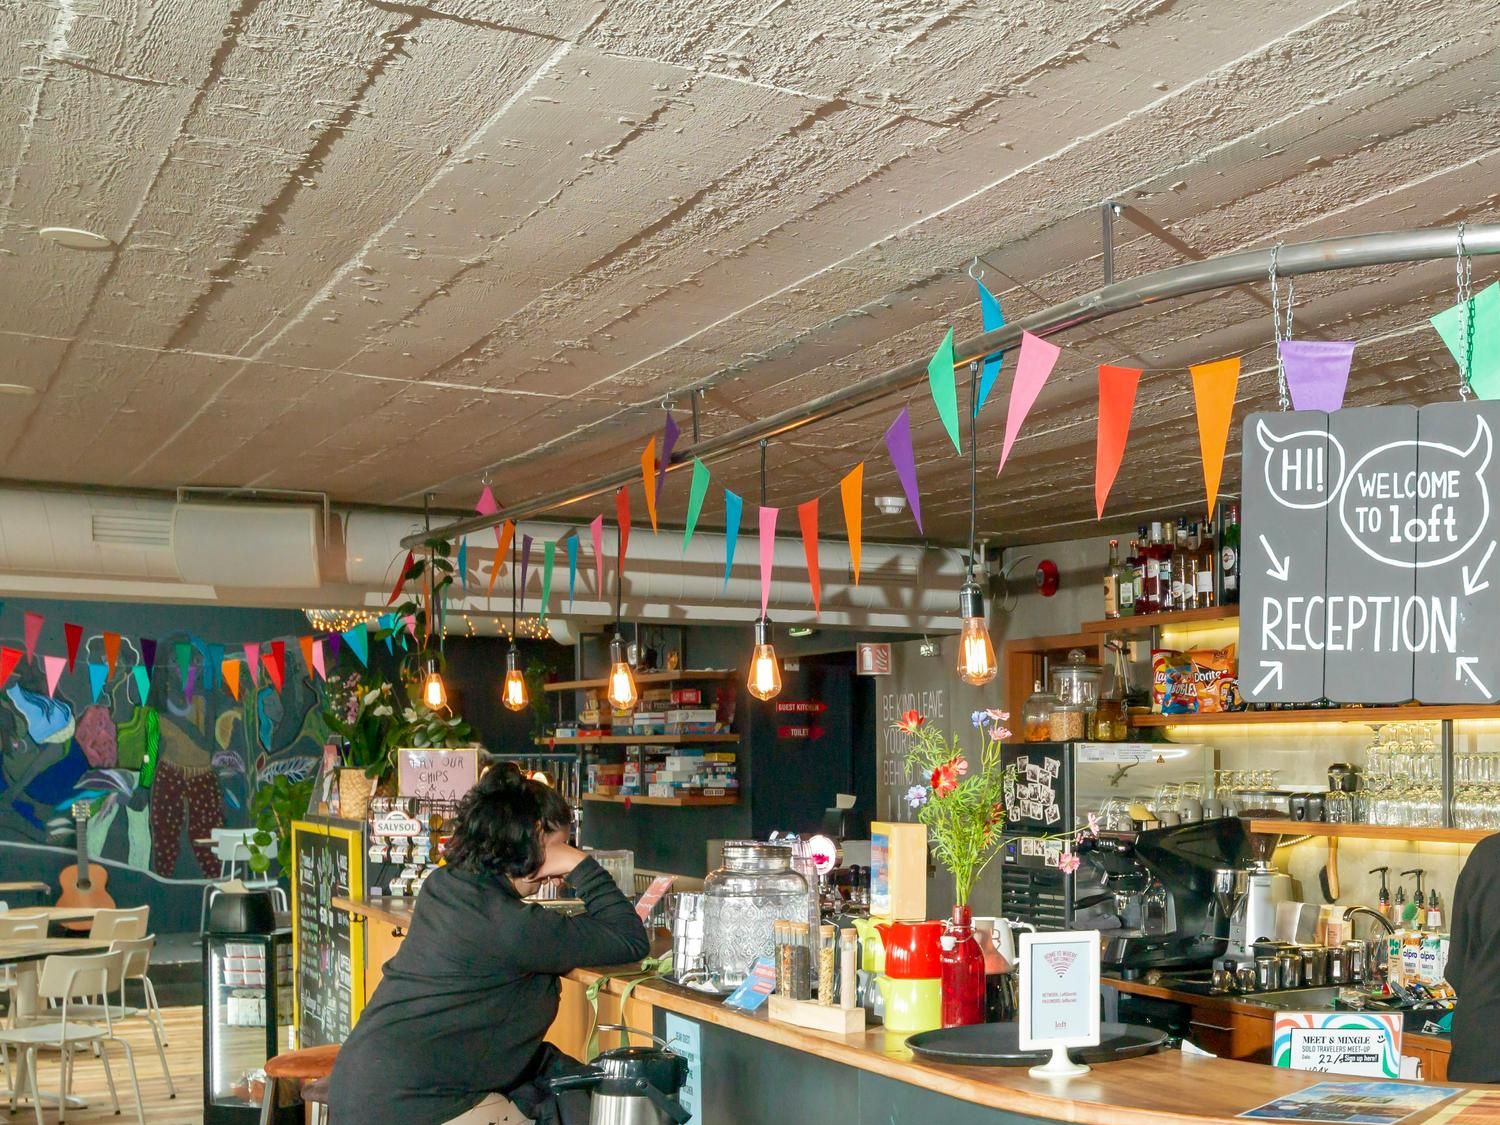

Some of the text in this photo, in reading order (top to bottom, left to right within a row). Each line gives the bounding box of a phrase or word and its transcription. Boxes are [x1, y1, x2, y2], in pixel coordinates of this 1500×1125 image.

[1281, 446, 1324, 492] HI!
[1357, 470, 1460, 499] WELCOME
[1355, 504, 1458, 543] TO loft
[1261, 595, 1457, 654] RECEPTION
[778, 703, 820, 712] GUEST KITCHEN
[883, 690, 944, 721] BE KIND LEAVE
[790, 728, 809, 736] TOILET
[883, 728, 907, 754] YOUR
[419, 770, 449, 784] CHIPS
[414, 789, 456, 801] SALSA
[377, 822, 417, 832] SALYSOL
[1403, 949, 1418, 960] alpro
[1420, 952, 1435, 961] alpro
[1302, 1035, 1326, 1044] MEET
[1339, 1035, 1370, 1044] MINGLE
[1302, 1045, 1371, 1053] SOLO TRAVELERS MEET-UP
[1344, 1054, 1356, 1062] Sign
